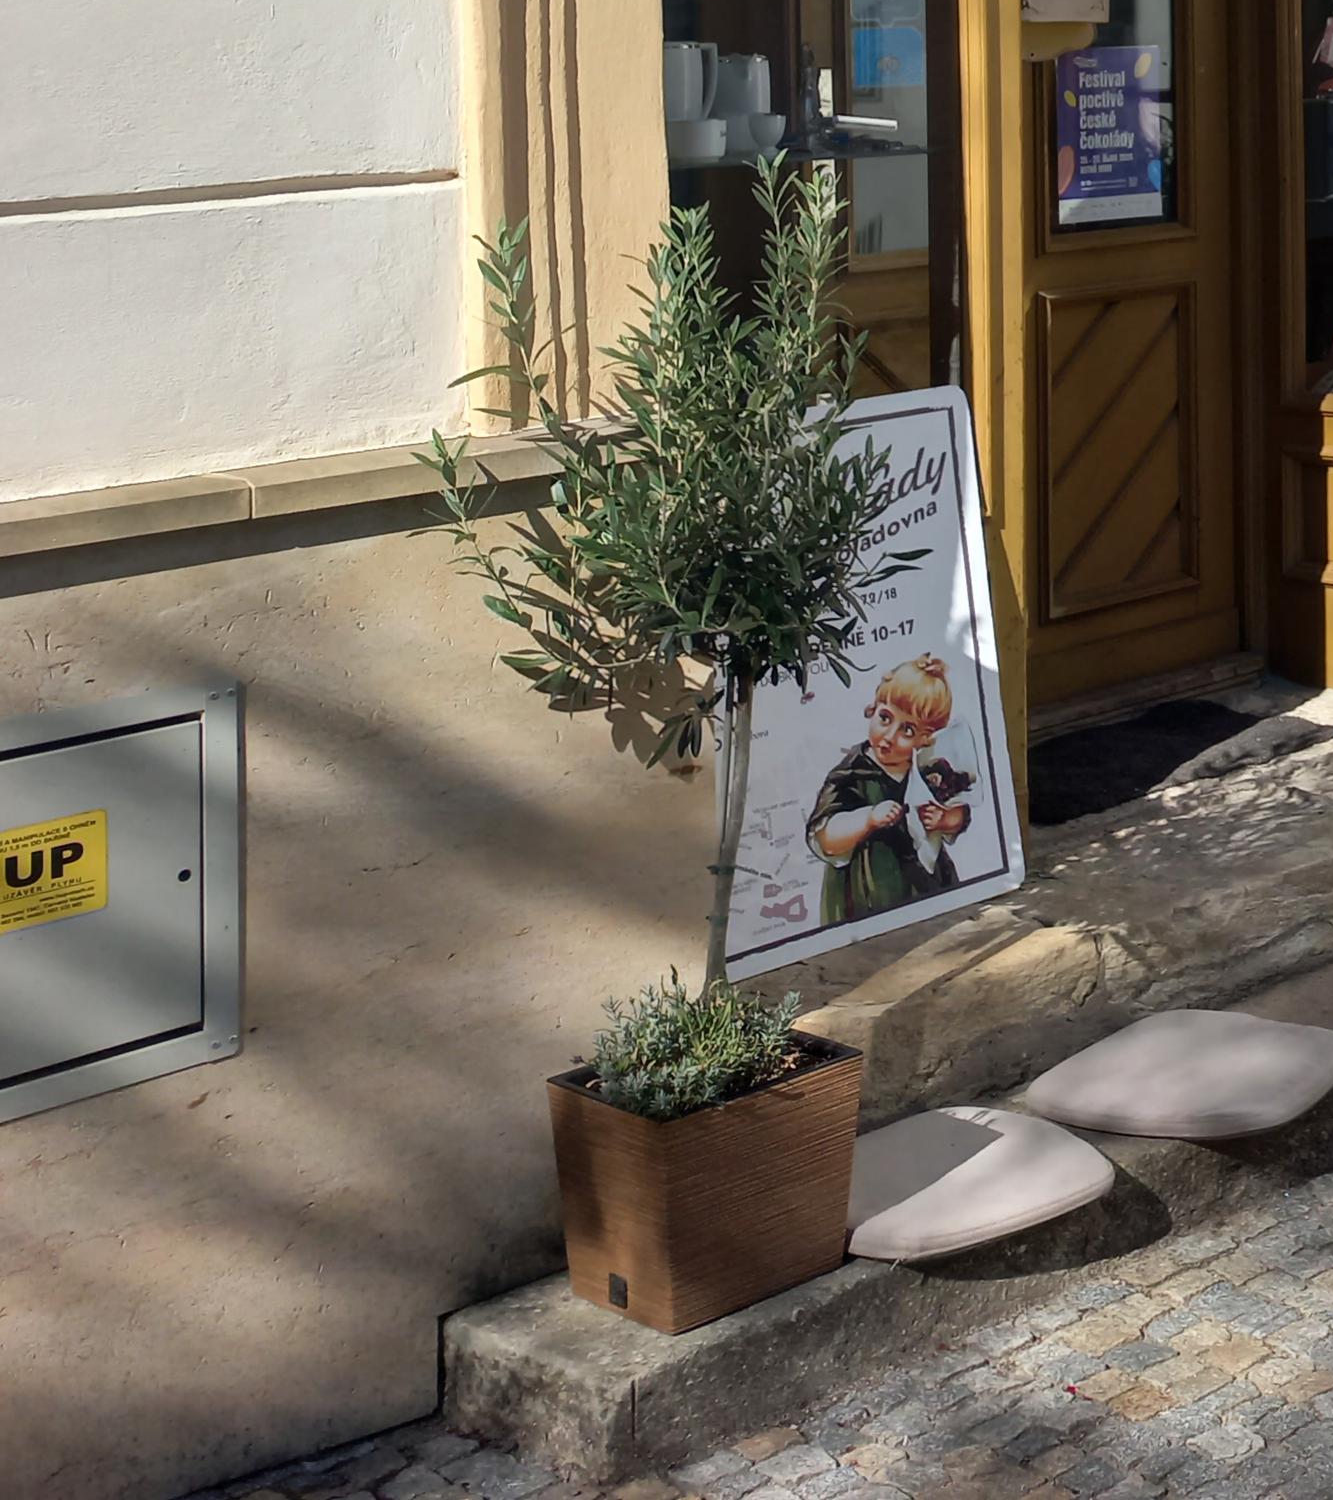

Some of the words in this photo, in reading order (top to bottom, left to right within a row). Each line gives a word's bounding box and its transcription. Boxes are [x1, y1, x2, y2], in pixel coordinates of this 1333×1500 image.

[1079, 70, 1125, 88] Festival
[871, 619, 915, 643] 10-17
[4, 842, 84, 888] UP
